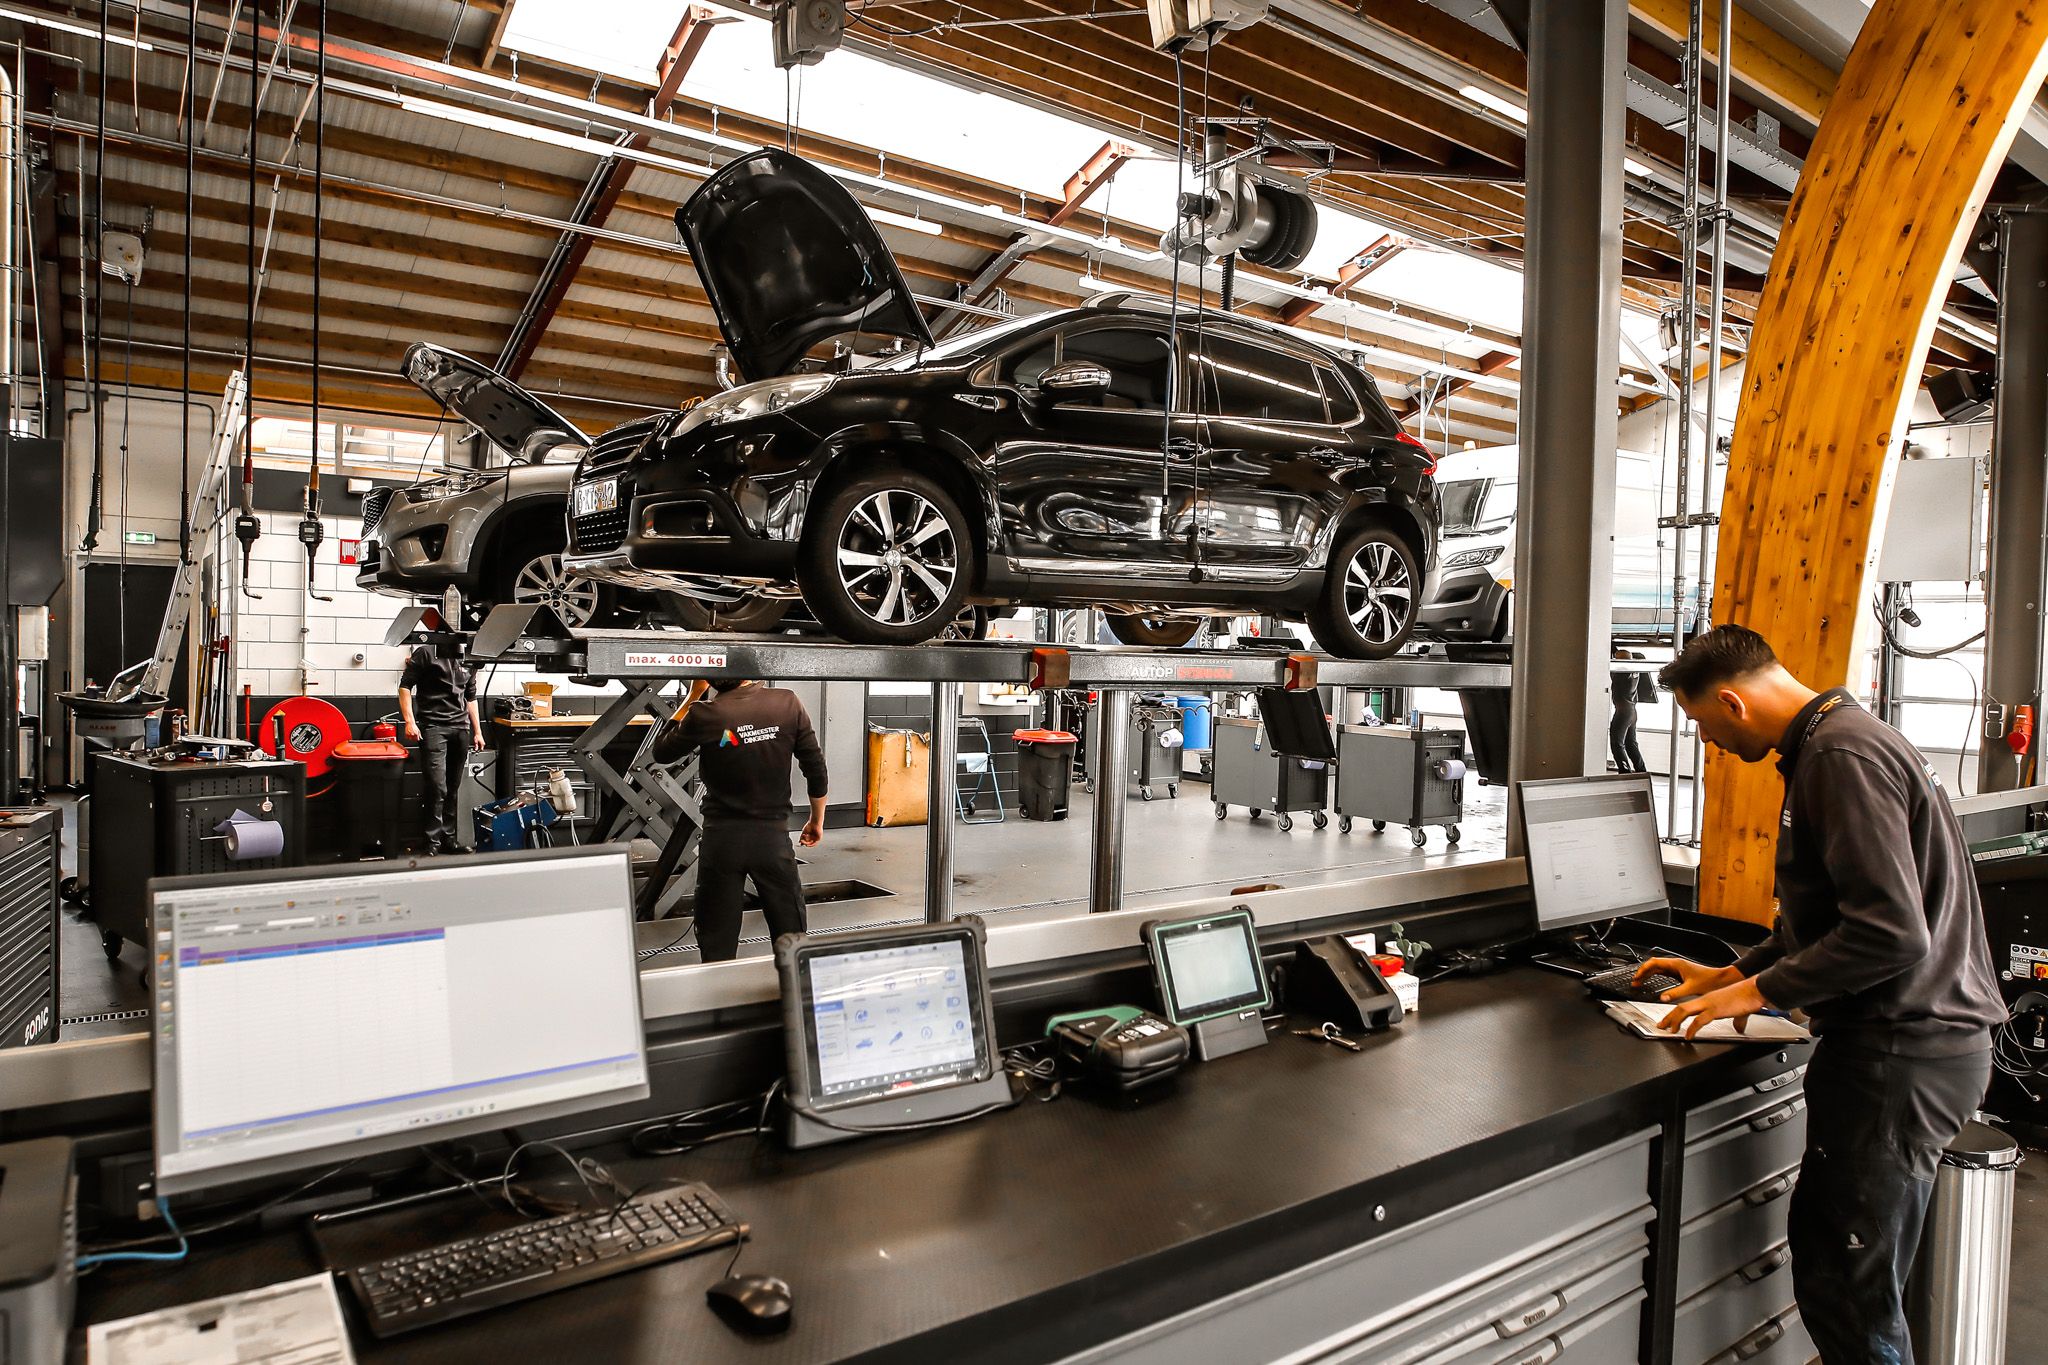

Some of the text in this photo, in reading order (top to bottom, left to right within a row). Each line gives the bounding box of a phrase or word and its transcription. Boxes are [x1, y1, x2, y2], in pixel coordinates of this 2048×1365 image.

[628, 655, 723, 667] max. 4000 kg
[1130, 666, 1174, 678] AUTOP
[736, 724, 754, 733] AUTO
